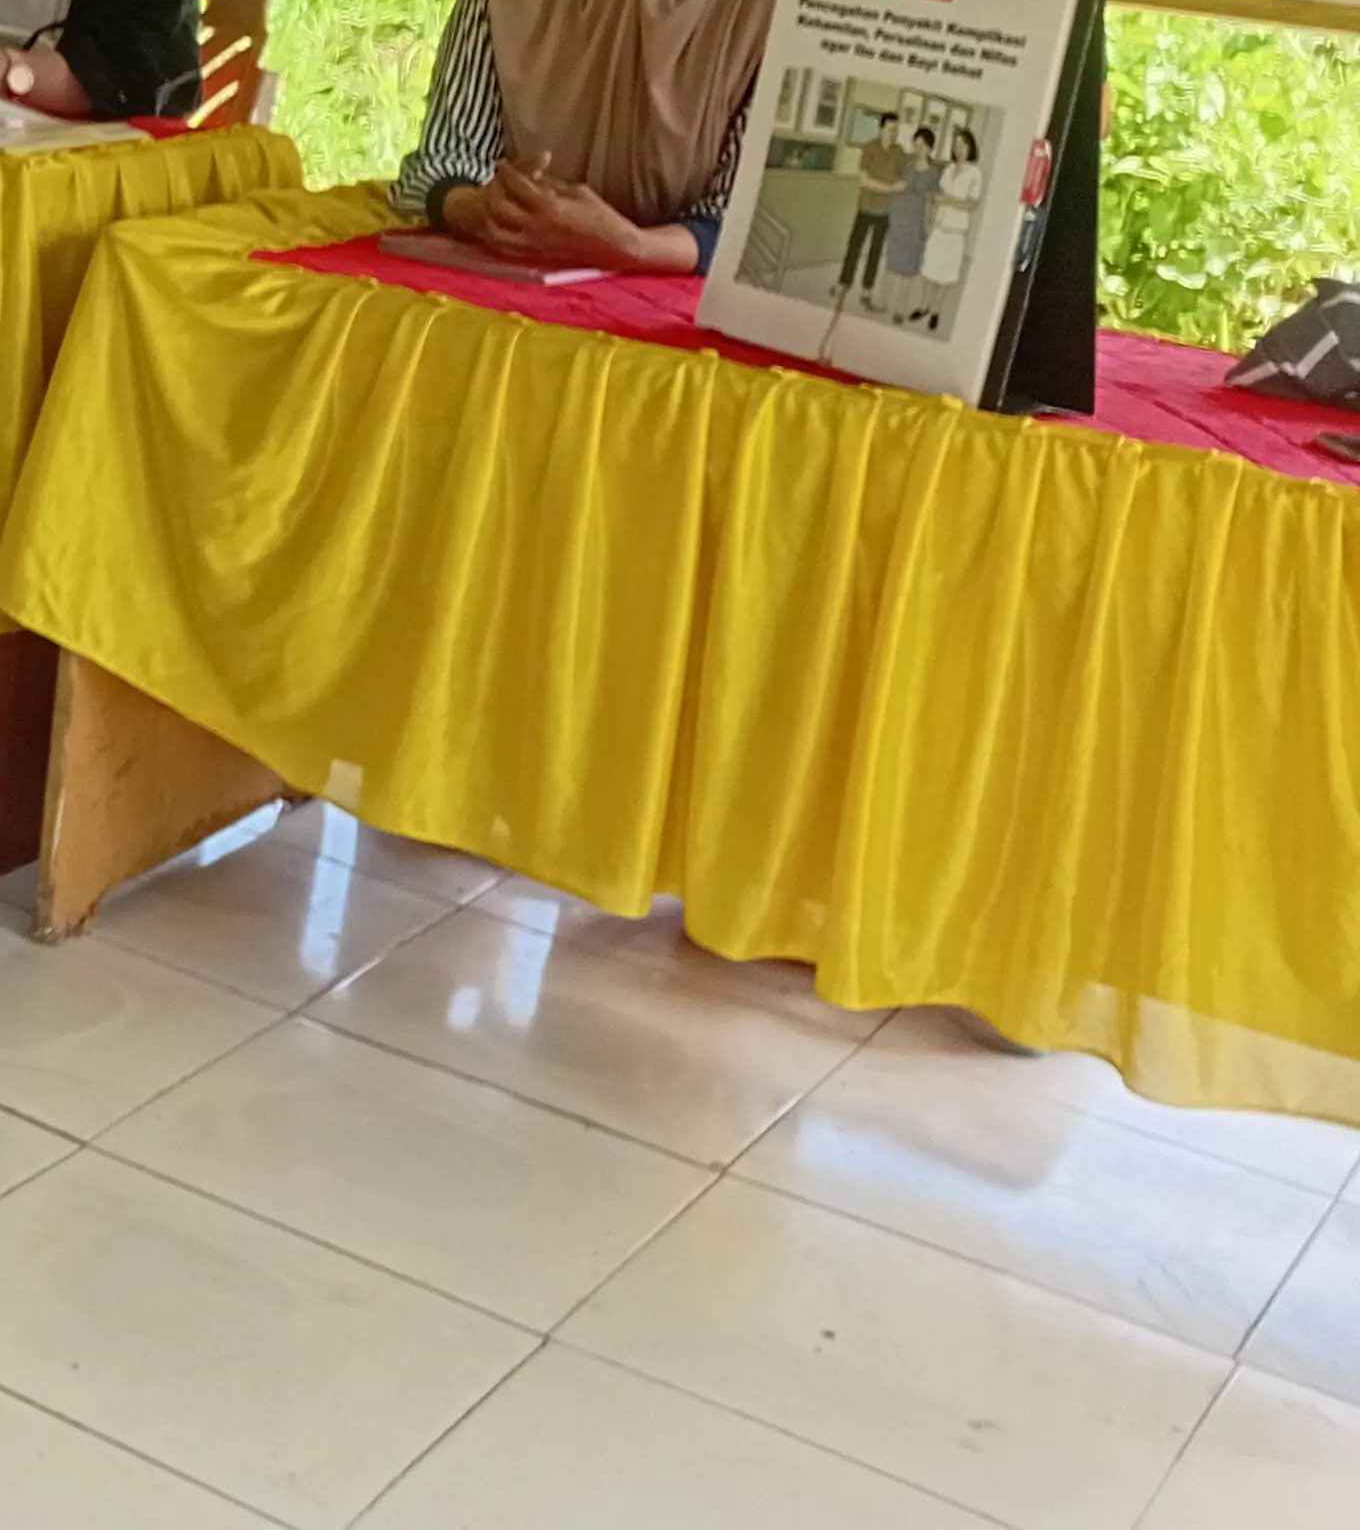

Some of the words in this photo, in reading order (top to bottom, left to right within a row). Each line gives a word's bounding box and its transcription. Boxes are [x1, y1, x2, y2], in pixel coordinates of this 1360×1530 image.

[875, 27, 946, 52] Persalinan
[950, 41, 976, 57] dan
[883, 10, 943, 32] Penyakit
[946, 23, 1027, 49] Komplikasi
[820, 39, 851, 55] agar
[879, 48, 904, 63] dan
